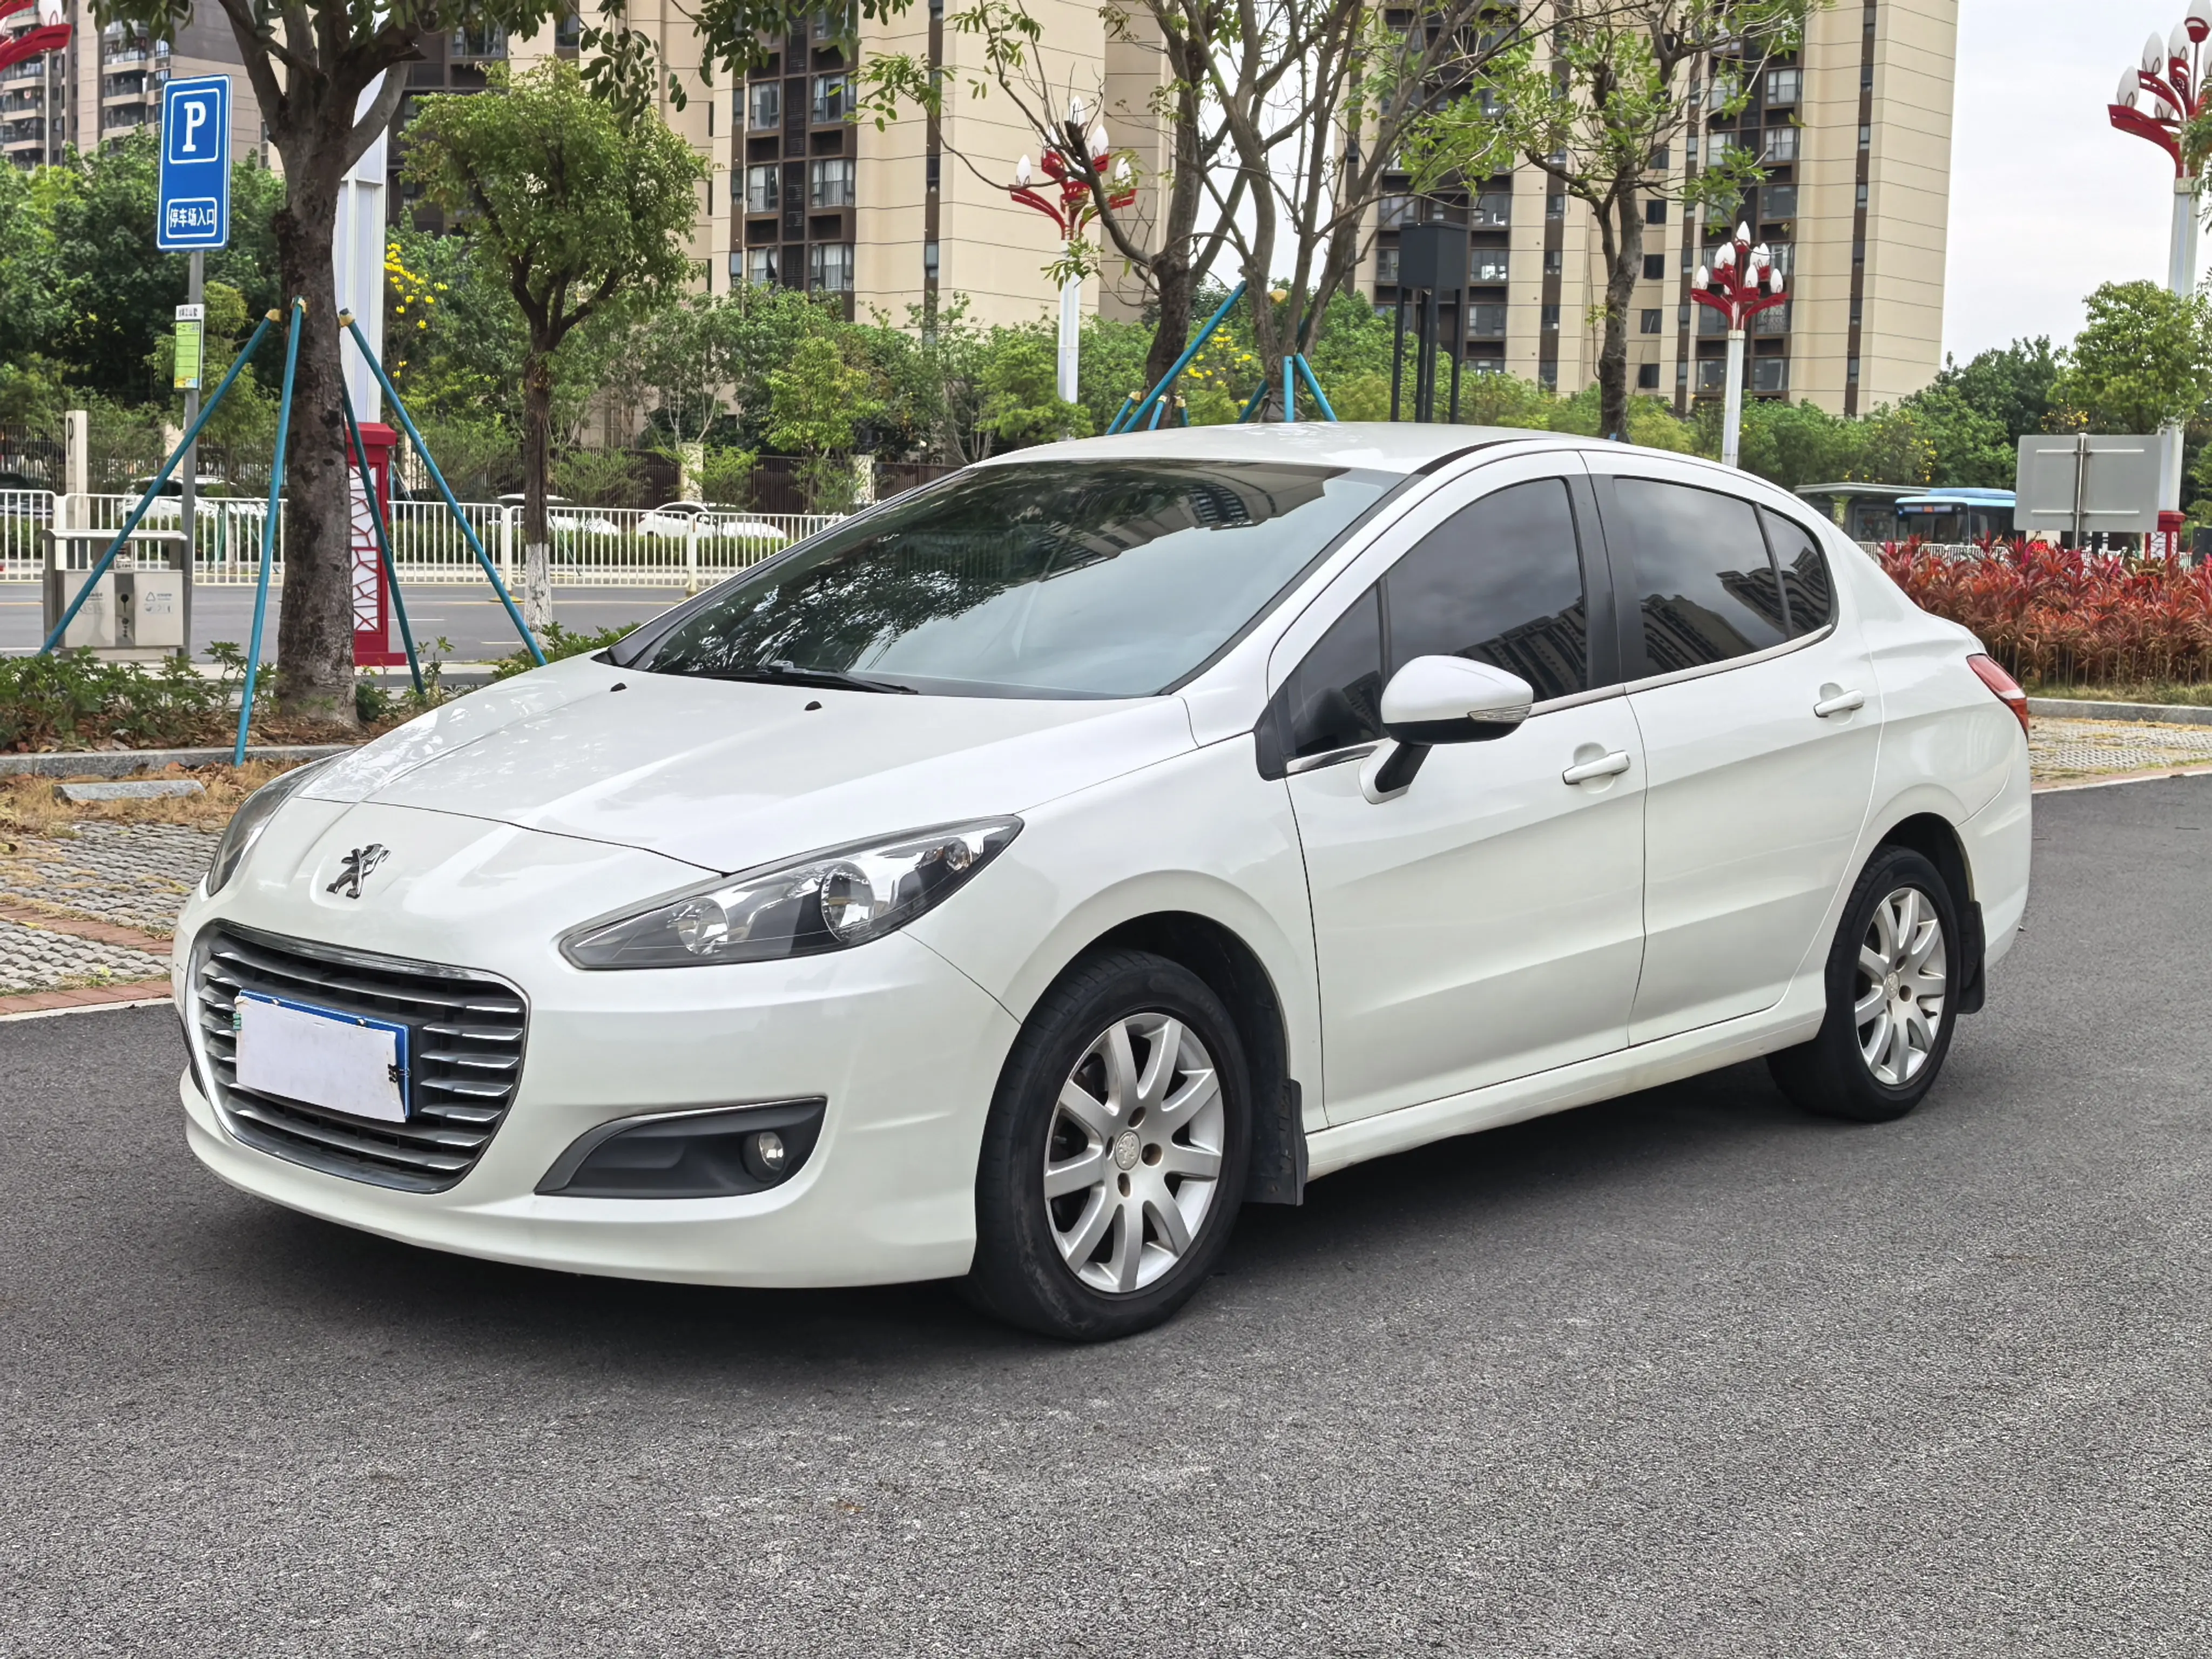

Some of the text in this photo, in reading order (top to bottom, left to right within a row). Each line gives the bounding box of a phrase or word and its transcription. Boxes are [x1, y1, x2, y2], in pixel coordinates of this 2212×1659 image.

[183, 101, 206, 152] P
[170, 207, 214, 228] 停车场入口
[68, 417, 74, 455] P
